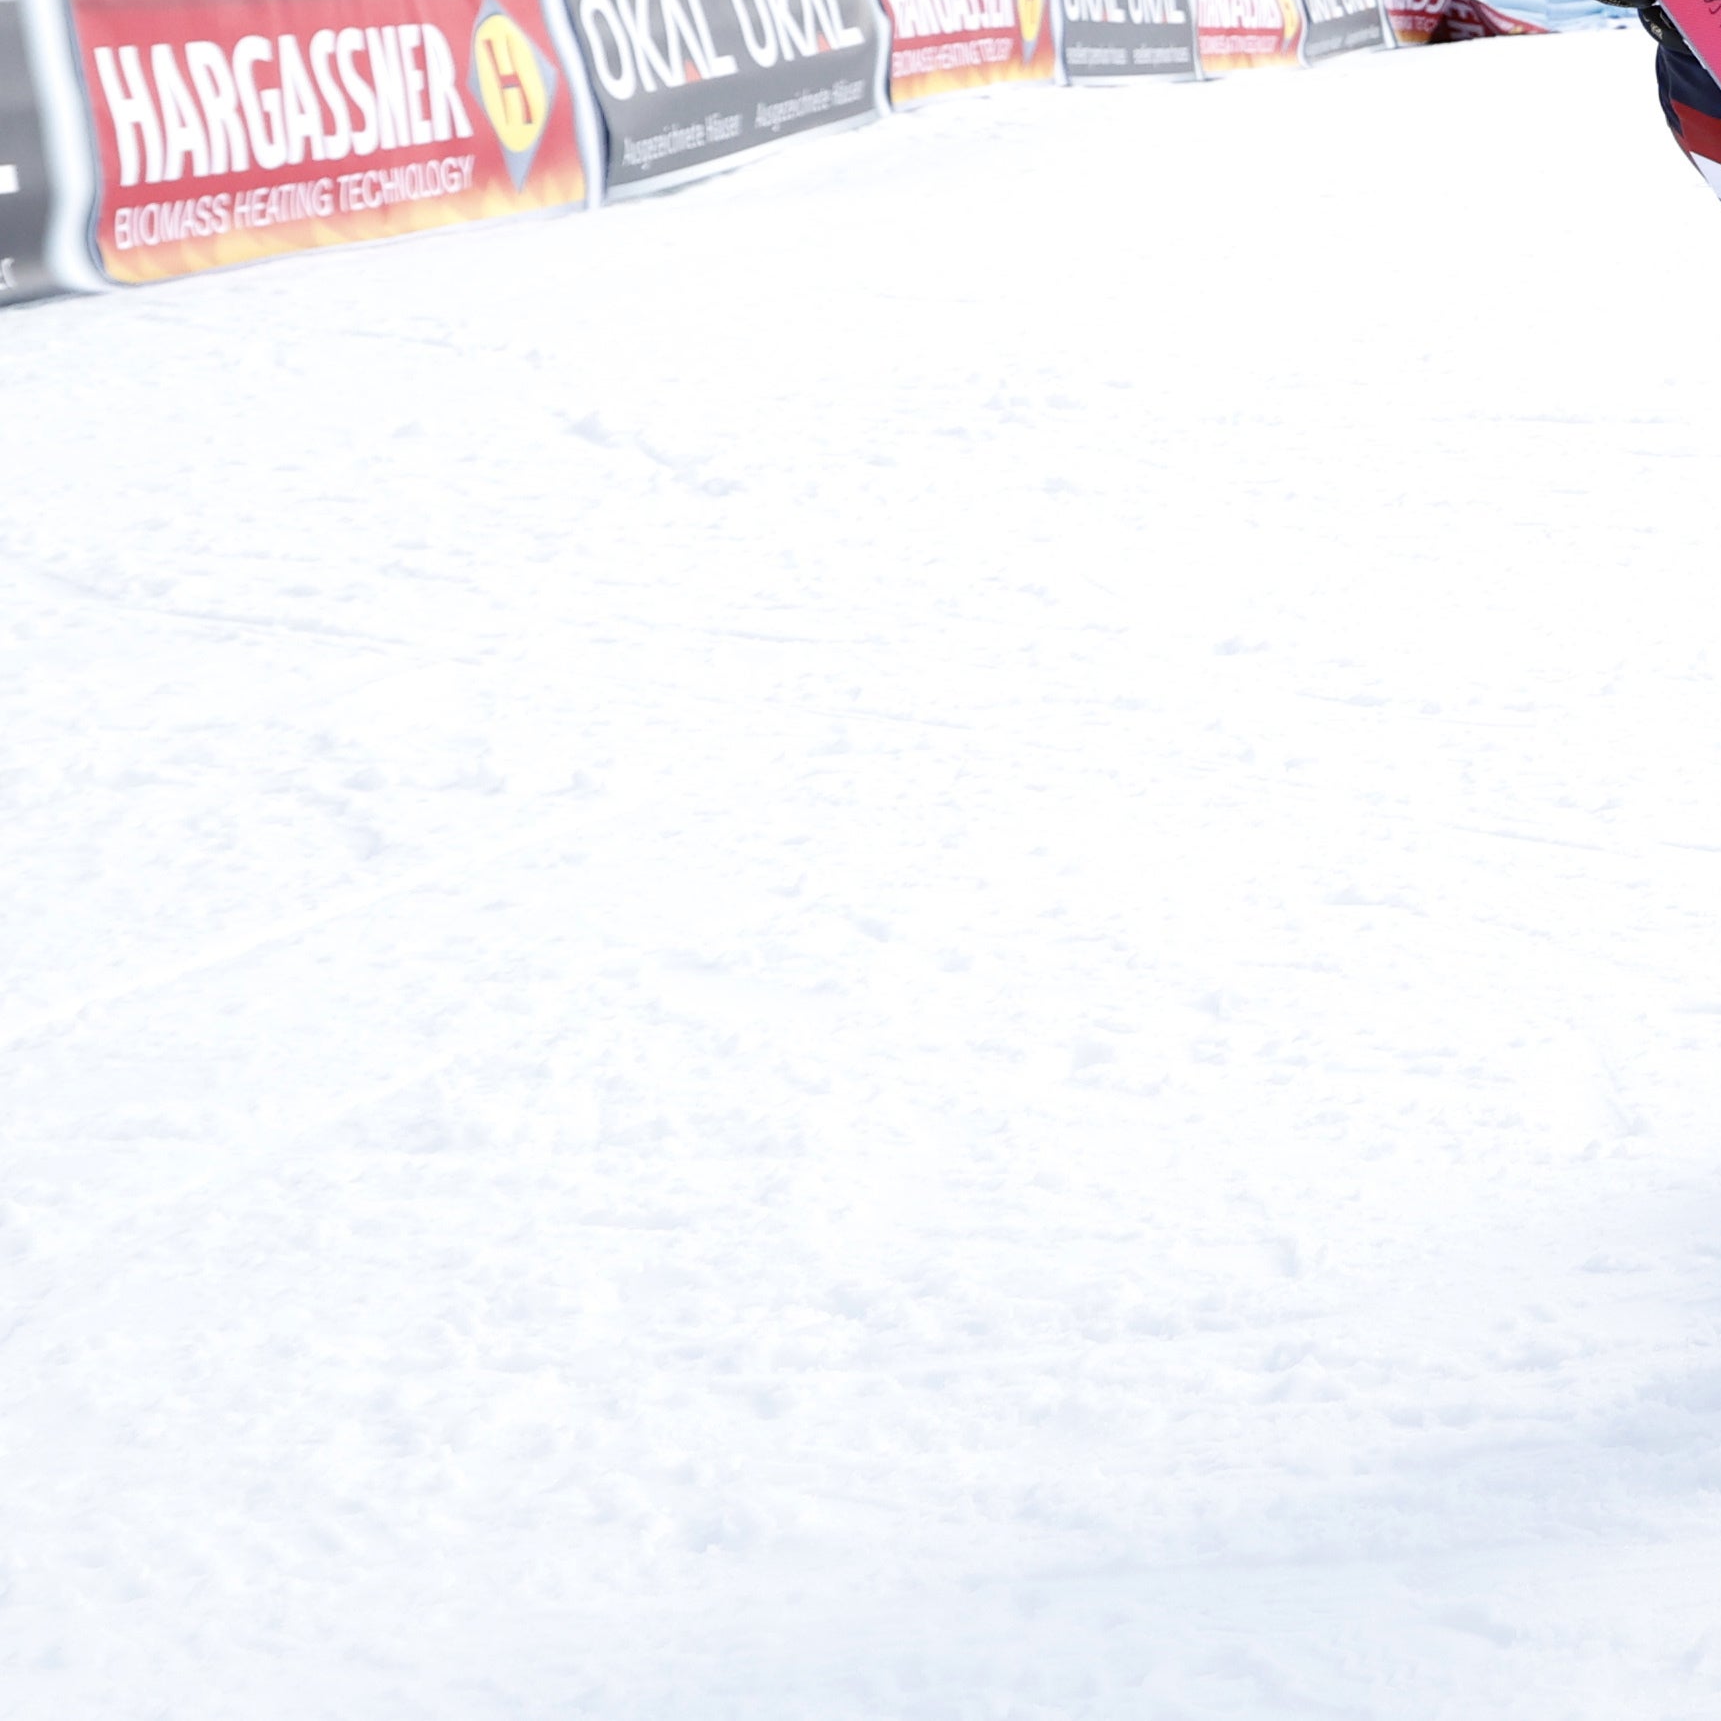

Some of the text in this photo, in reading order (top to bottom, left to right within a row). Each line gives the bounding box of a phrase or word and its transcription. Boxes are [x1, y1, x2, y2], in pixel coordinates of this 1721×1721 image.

[94, 23, 473, 187] HARGASSNER
[114, 154, 476, 252] BIOMASS HEATING TECHNOLOGY
